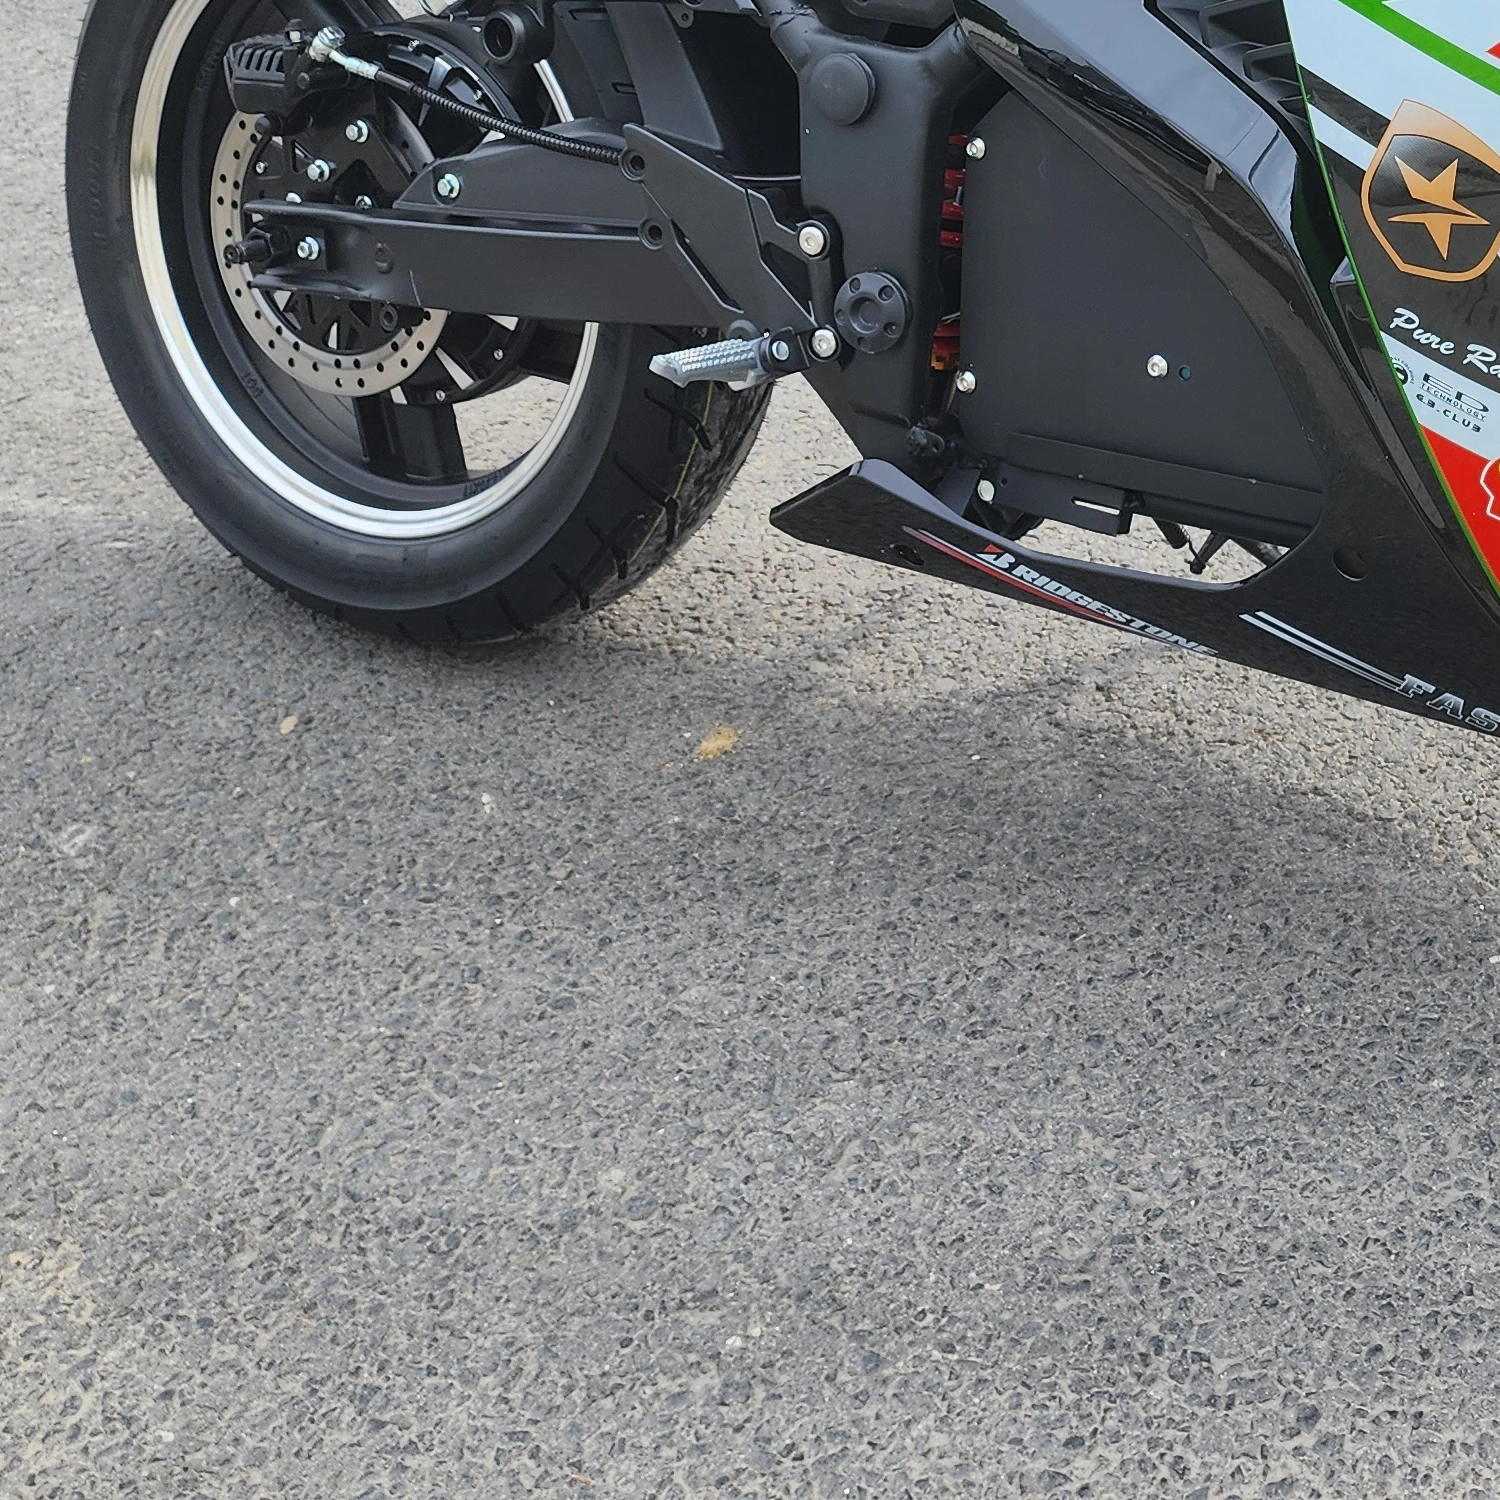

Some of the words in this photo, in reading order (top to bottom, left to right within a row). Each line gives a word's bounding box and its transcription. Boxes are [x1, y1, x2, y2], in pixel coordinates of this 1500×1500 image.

[1389, 307, 1455, 355] Pure
[1420, 381, 1487, 422] TECHNOLOGY
[975, 544, 1219, 655] BRIDGESTONE
